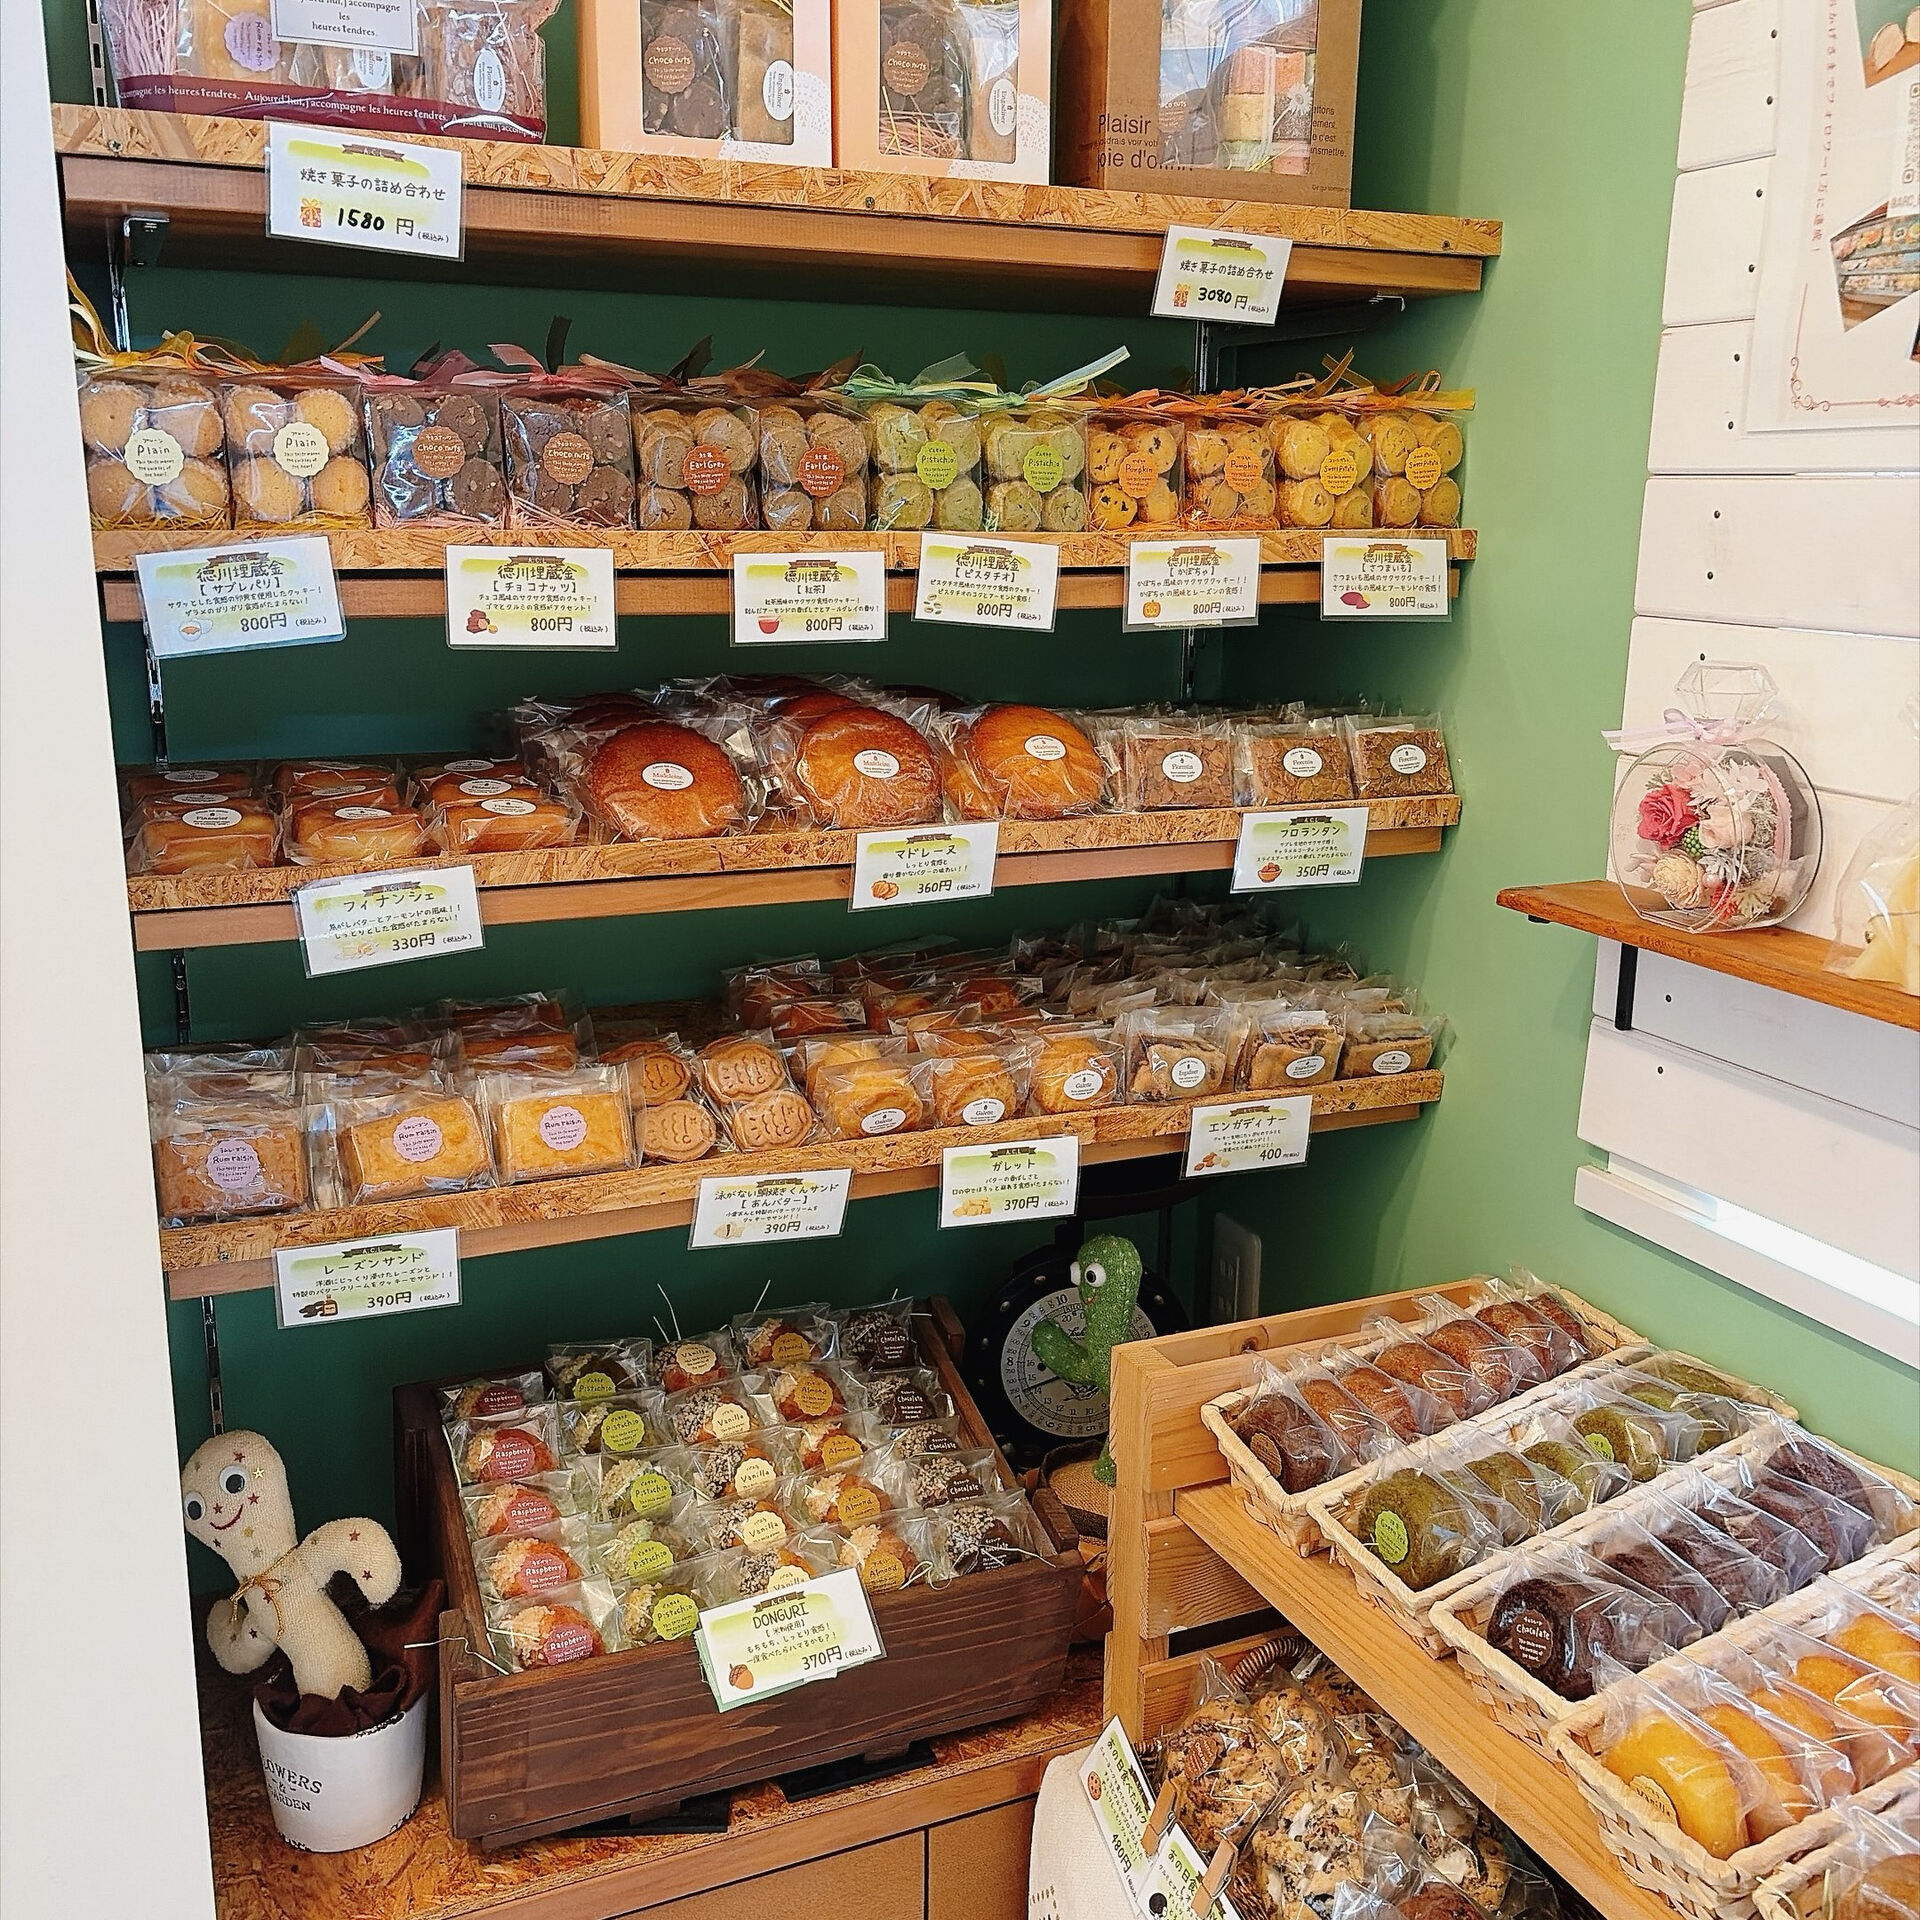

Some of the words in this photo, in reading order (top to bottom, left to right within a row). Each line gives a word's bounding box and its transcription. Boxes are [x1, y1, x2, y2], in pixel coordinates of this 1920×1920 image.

[339, 12, 350, 21] les
[312, 21, 340, 32] heures
[168, 87, 200, 97] heures
[369, 104, 381, 113] les
[383, 106, 413, 117] heures
[1098, 113, 1152, 135] Plaisir
[300, 168, 447, 201] 焼き菓子の詰め合わせ
[338, 207, 385, 231] 1580
[396, 217, 414, 237] 円
[1180, 259, 1275, 280] 焼き菓子の詰め合わせ
[1198, 287, 1232, 304] 3080
[1234, 295, 1249, 310] 円
[137, 444, 170, 457] Plain
[285, 438, 317, 448] Plain
[1125, 463, 1153, 474] Pumpkin
[1230, 461, 1258, 471] Pumpkin
[955, 552, 1022, 572] 徳川埋蔵金
[1167, 554, 1223, 568] 徳川埋蔵金
[1362, 551, 1414, 564] 徳川埋蔵金
[196, 559, 285, 583] 徳川埋蔵金
[497, 564, 577, 582] 徳川埋蔵金
[784, 569, 843, 583] 徳川埋蔵金
[1193, 602, 1221, 615] 800円
[1389, 596, 1416, 608] 800円
[976, 602, 1013, 618] 800円
[240, 612, 287, 633] 800円
[531, 616, 573, 632] 800円
[805, 616, 843, 632] 800円
[1280, 826, 1341, 839] フロランタン
[895, 844, 957, 860] マドレーヌ
[1295, 863, 1330, 878] 350円
[917, 880, 953, 895] 360円
[343, 891, 435, 913] フィナンシェ
[392, 931, 435, 951] 330円
[544, 1121, 560, 1130] Rum
[1208, 1115, 1287, 1133] エンガディナー
[398, 1132, 415, 1141] Rum
[213, 1155, 230, 1165] Rum
[1259, 1147, 1282, 1162] 400
[992, 1158, 1036, 1172] ガレット
[1004, 1195, 1040, 1211] 370円
[764, 1220, 801, 1235] 390円
[325, 1252, 425, 1275] レーズンサンド
[367, 1291, 412, 1309] 390円
[681, 1349, 709, 1359] Vanilla
[579, 1384, 612, 1392] Pistachio
[1055, 1404, 1064, 1412] 12
[606, 1419, 639, 1433] Pistachio
[717, 1412, 744, 1426] Vanilla
[495, 1448, 532, 1459] Raspberry
[829, 1445, 856, 1454] Almond
[740, 1470, 770, 1484] Vanilla
[635, 1485, 668, 1497] Pistachio
[511, 1505, 549, 1518] Raspberry
[844, 1498, 873, 1513] Almond
[748, 1522, 779, 1538] Vanilla
[633, 1550, 668, 1569] Pistachio
[526, 1563, 564, 1576] Raspberry
[868, 1565, 898, 1578] Almond
[657, 1604, 694, 1620] Pistachio
[752, 1602, 810, 1630] DONGURI
[1516, 1623, 1550, 1641] Chocolate
[550, 1634, 588, 1651] Raspberry
[801, 1645, 843, 1671] 370円
[1111, 1833, 1132, 1874] 480円
